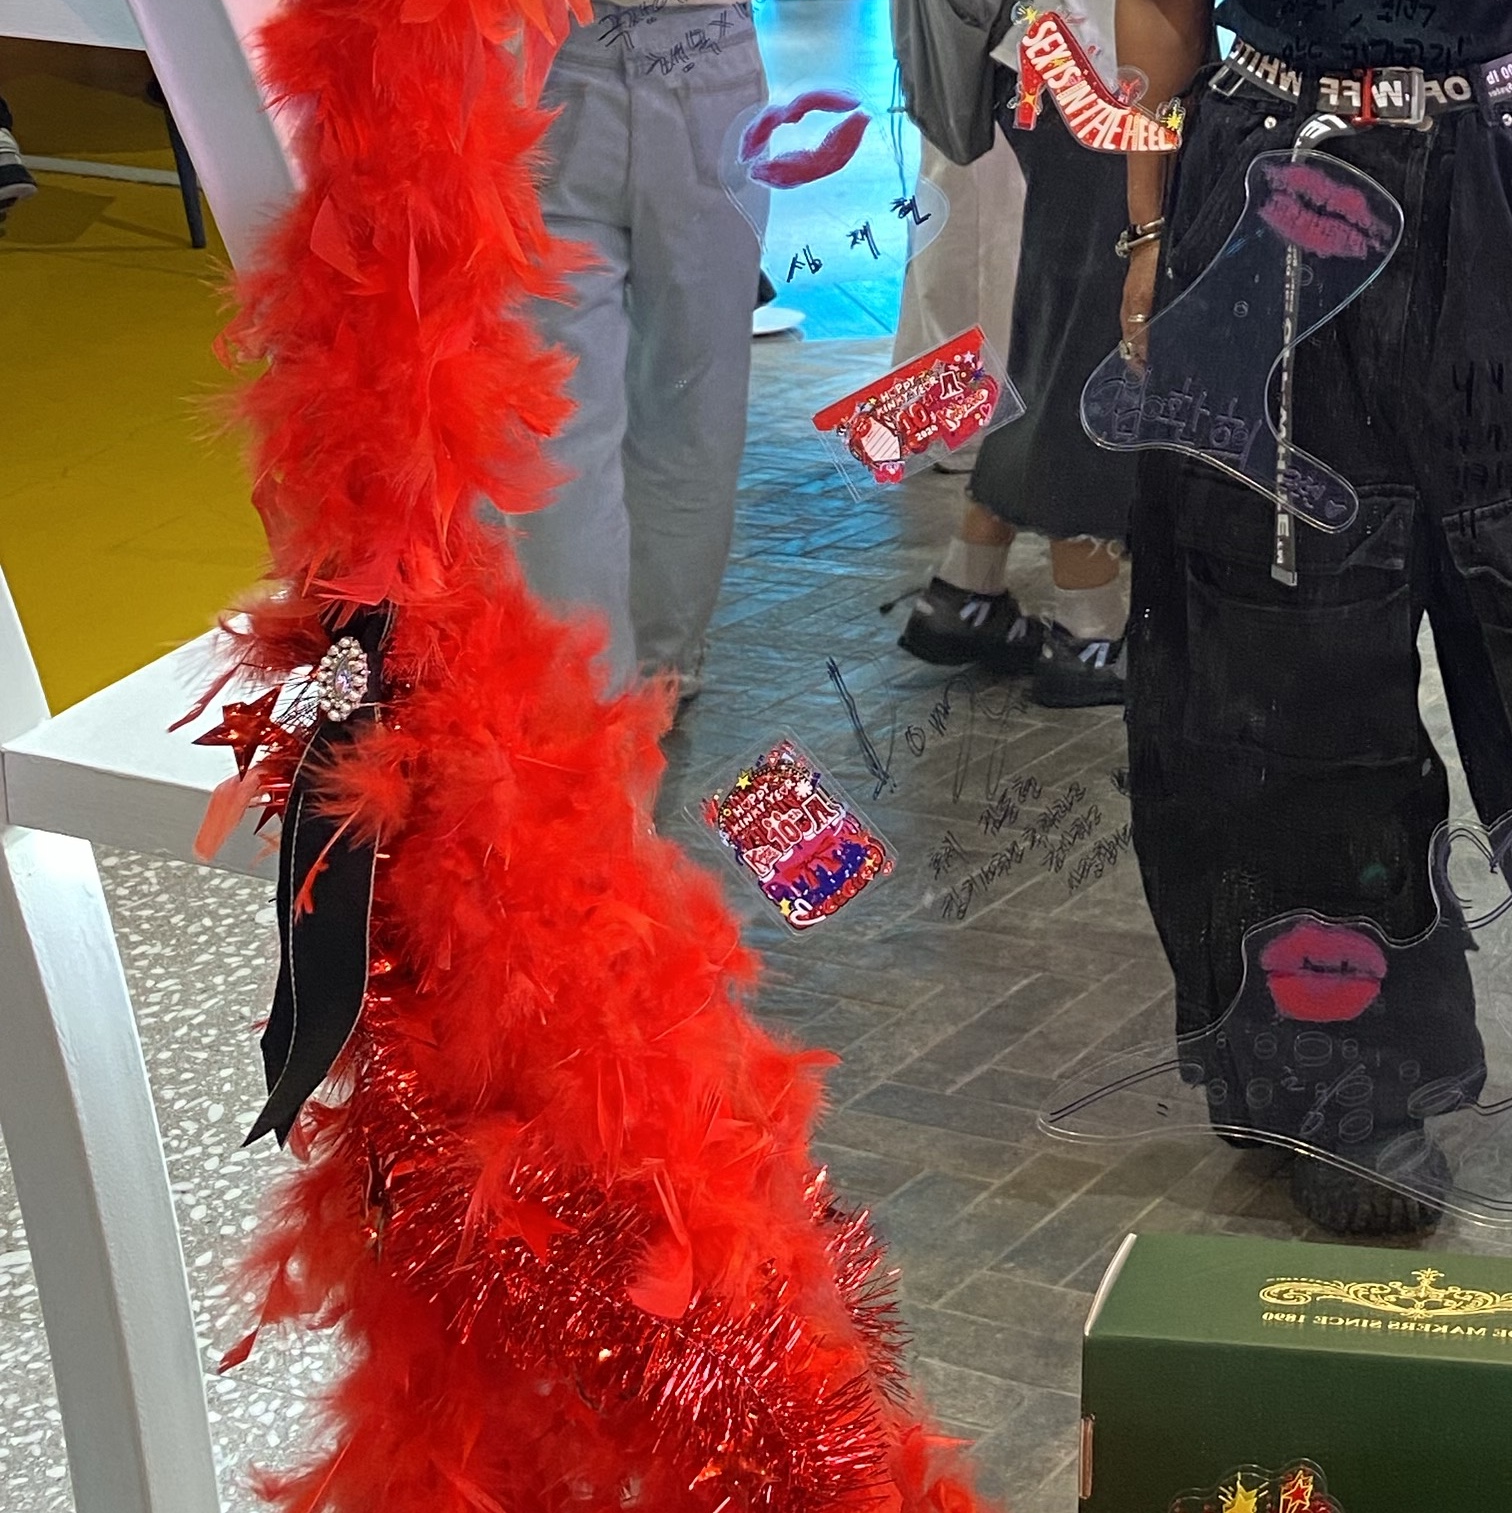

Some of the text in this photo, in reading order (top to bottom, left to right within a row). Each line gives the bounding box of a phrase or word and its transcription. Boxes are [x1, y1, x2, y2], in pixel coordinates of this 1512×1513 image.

[1022, 21, 1072, 71] SEX
[1042, 59, 1082, 88] IS
[1120, 113, 1177, 151] HEEL
[914, 424, 939, 441] 2024
